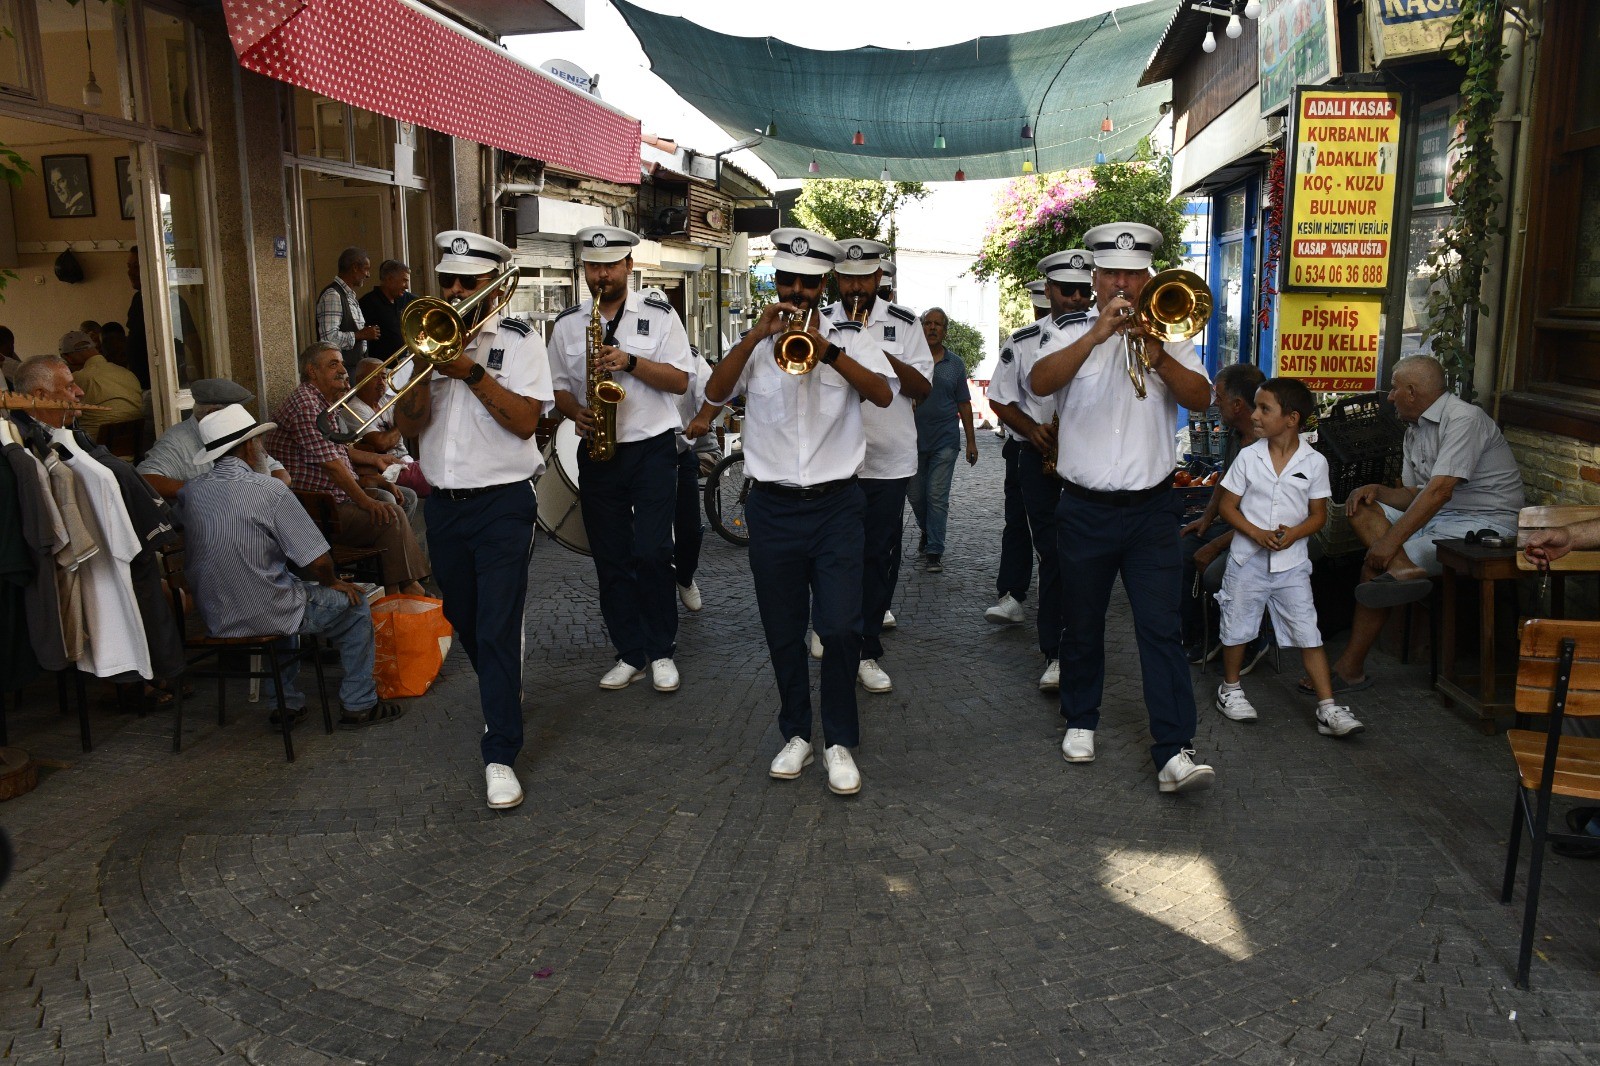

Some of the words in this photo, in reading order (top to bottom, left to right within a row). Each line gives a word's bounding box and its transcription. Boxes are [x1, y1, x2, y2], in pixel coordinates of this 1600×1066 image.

[1308, 101, 1346, 116] ADALI
[1350, 101, 1393, 116] KASAP
[1307, 126, 1390, 142] KURBANLIK
[1316, 151, 1378, 167] ADAKLIK
[1303, 175, 1333, 194] KOÇ
[1345, 175, 1385, 191] KUZU
[1310, 199, 1377, 215] BULUNUR
[1297, 219, 1322, 235] KESİM
[1324, 219, 1357, 235] HİZMETİ
[1358, 219, 1389, 235] VERİLİR
[1298, 242, 1327, 255] KASAP
[1331, 242, 1358, 258] YAŞAR
[1360, 242, 1382, 256] USTA
[1295, 265, 1302, 283] 0
[1305, 265, 1326, 283] 534
[1329, 265, 1342, 283] 06
[1345, 265, 1359, 283] 36
[1362, 265, 1383, 283] 888
[1301, 305, 1359, 331] PİŞMİŞ
[1281, 334, 1323, 351] KUZU
[1328, 334, 1377, 351] KELLE
[1280, 355, 1317, 375] SATIŞ
[1320, 356, 1376, 373] NOKTASI
[1332, 379, 1363, 389] Usta
